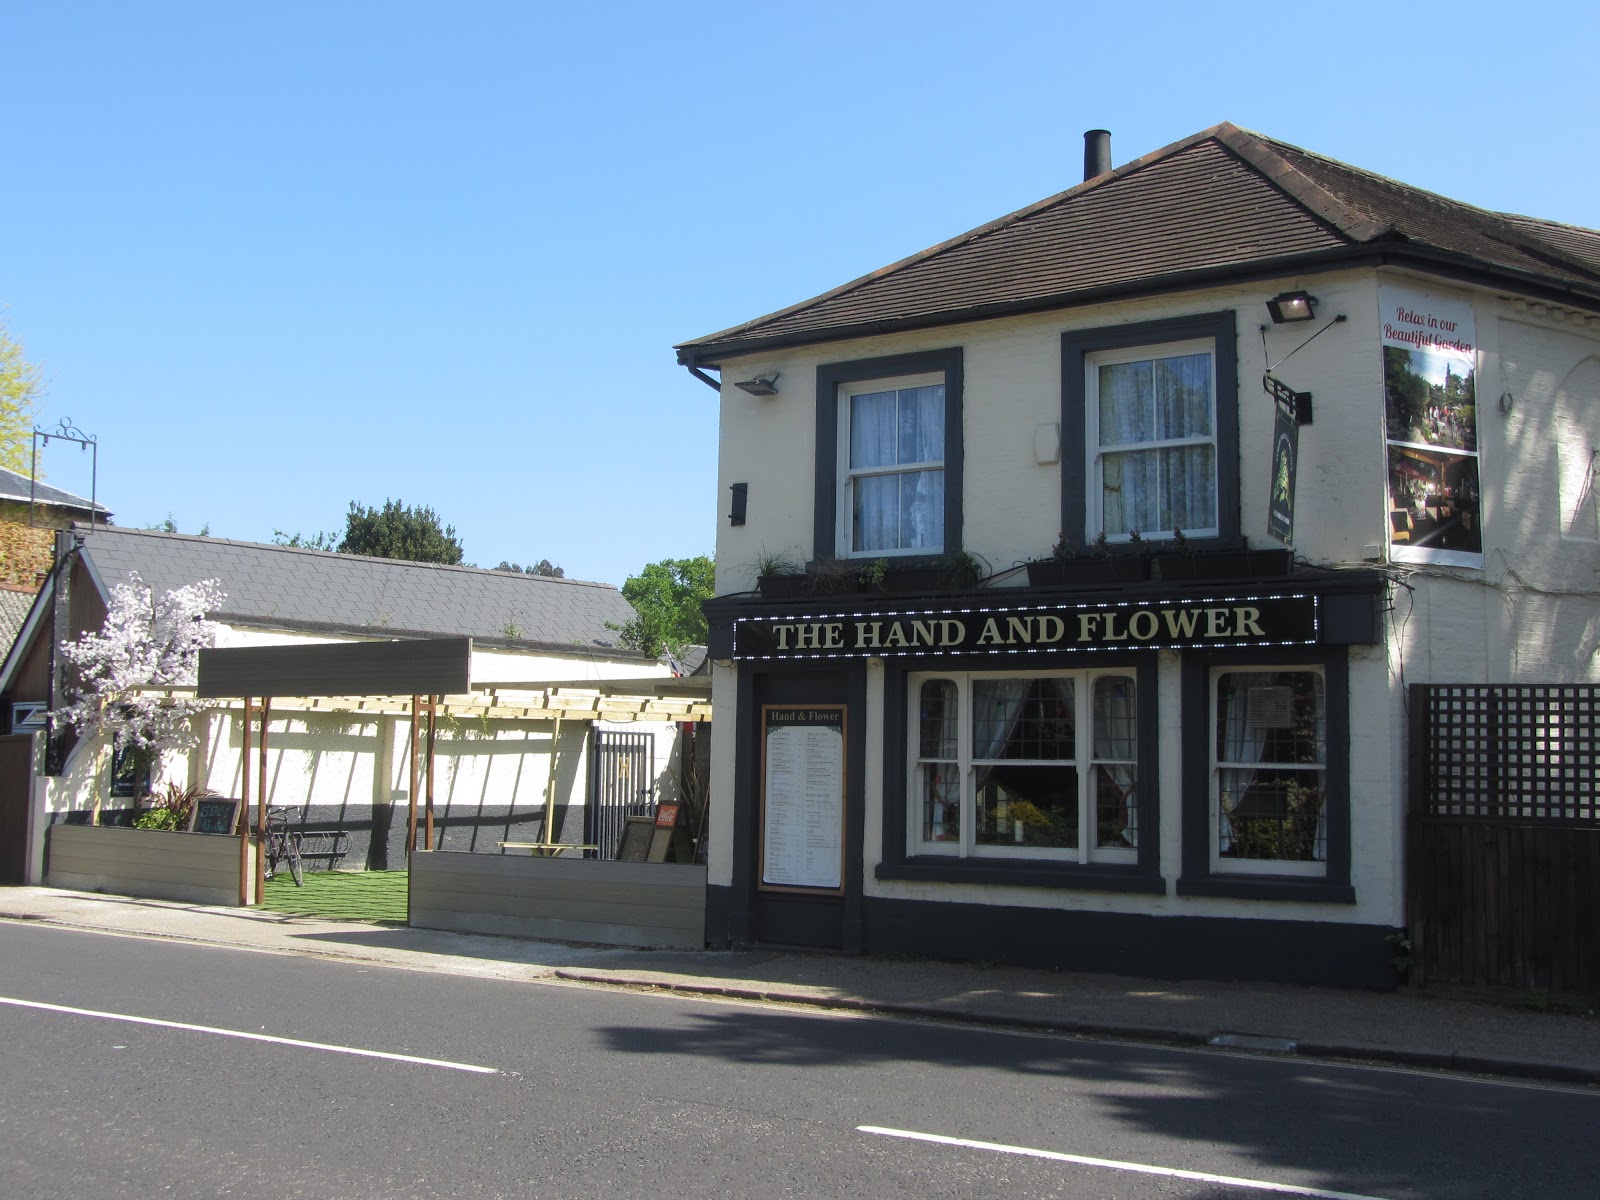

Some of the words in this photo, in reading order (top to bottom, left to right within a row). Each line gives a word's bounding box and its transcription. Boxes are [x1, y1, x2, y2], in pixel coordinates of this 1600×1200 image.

[1396, 307, 1425, 326] Relax
[1427, 314, 1438, 328] in
[1440, 320, 1457, 332] our
[1384, 323, 1432, 349] Beautiful
[1434, 333, 1472, 353] Garden
[772, 623, 844, 650] THE
[854, 619, 966, 648] HAND
[976, 615, 1066, 645] AND
[1077, 606, 1265, 642] FLOWER
[772, 711, 795, 721] Hand
[797, 711, 806, 721] &
[809, 711, 839, 721] Flower
